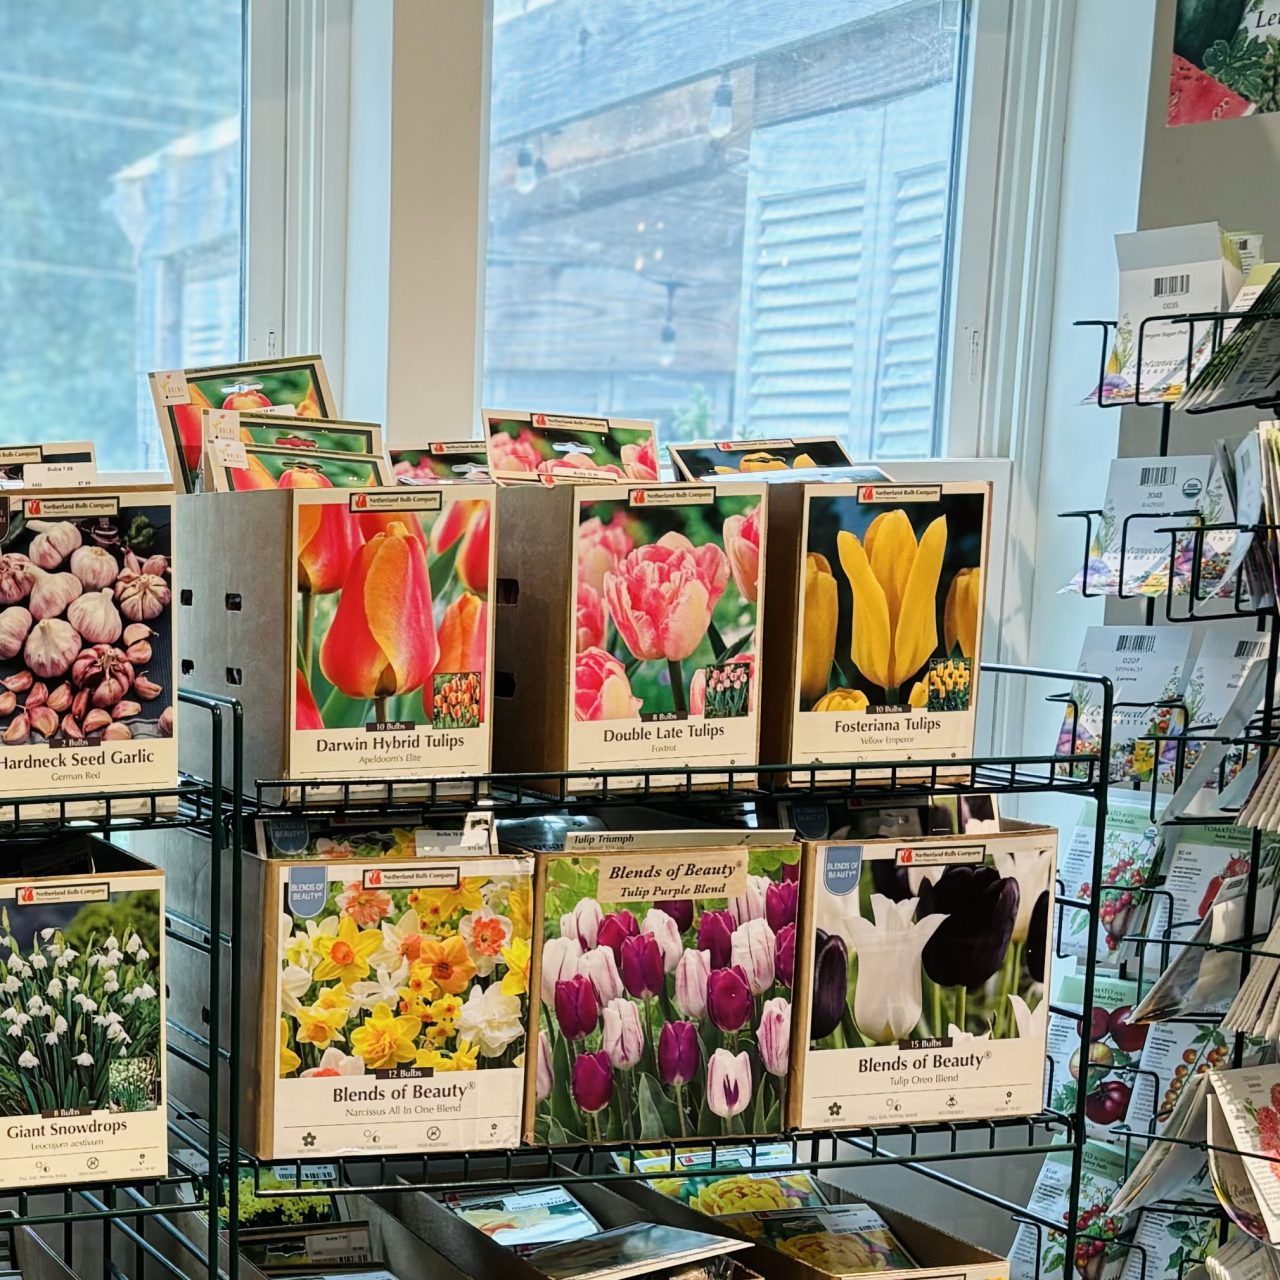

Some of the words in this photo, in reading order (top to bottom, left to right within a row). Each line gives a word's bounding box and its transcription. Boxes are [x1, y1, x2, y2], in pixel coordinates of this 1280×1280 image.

[43, 503, 74, 511] Netherland
[89, 502, 115, 511] Company
[835, 719, 900, 733] Fosteriana
[905, 717, 941, 733] Tulips
[604, 727, 651, 742] Double
[657, 725, 683, 740] Late
[688, 723, 725, 741] Tulips
[317, 737, 367, 752] Darwin
[373, 735, 420, 753] Hybrid
[425, 733, 464, 749] Tulips
[860, 736, 883, 745] Yellow
[886, 736, 915, 745] Emperor
[652, 744, 676, 753] Foxtrot
[72, 751, 106, 767] Seed
[111, 749, 154, 764] Garlic
[51, 773, 83, 781] German
[86, 771, 101, 780] Red
[574, 836, 595, 844] Tulip
[598, 834, 634, 844] Triumph
[609, 865, 662, 880] Blends
[666, 864, 682, 880] of
[292, 884, 314, 892] BLENDS
[620, 886, 650, 898] Tulip
[652, 884, 691, 897] Purple
[694, 883, 726, 894] Blend
[911, 1040, 919, 1048] 15
[921, 1039, 942, 1047] Bulbs
[859, 1056, 907, 1073] Blends
[913, 1054, 929, 1070] of
[400, 1069, 422, 1078] Bulbs
[890, 1076, 909, 1086] Tulip
[912, 1075, 933, 1084] Oreo
[936, 1074, 959, 1083] Blend
[333, 1086, 385, 1102] Blends
[391, 1084, 409, 1100] of
[346, 1107, 386, 1117] Narcissus
[389, 1106, 400, 1115] All
[403, 1106, 412, 1114] In
[414, 1105, 434, 1114] One
[437, 1104, 462, 1113] Blend
[7, 1125, 45, 1139] Giant
[51, 1119, 127, 1136] Snowdrops
